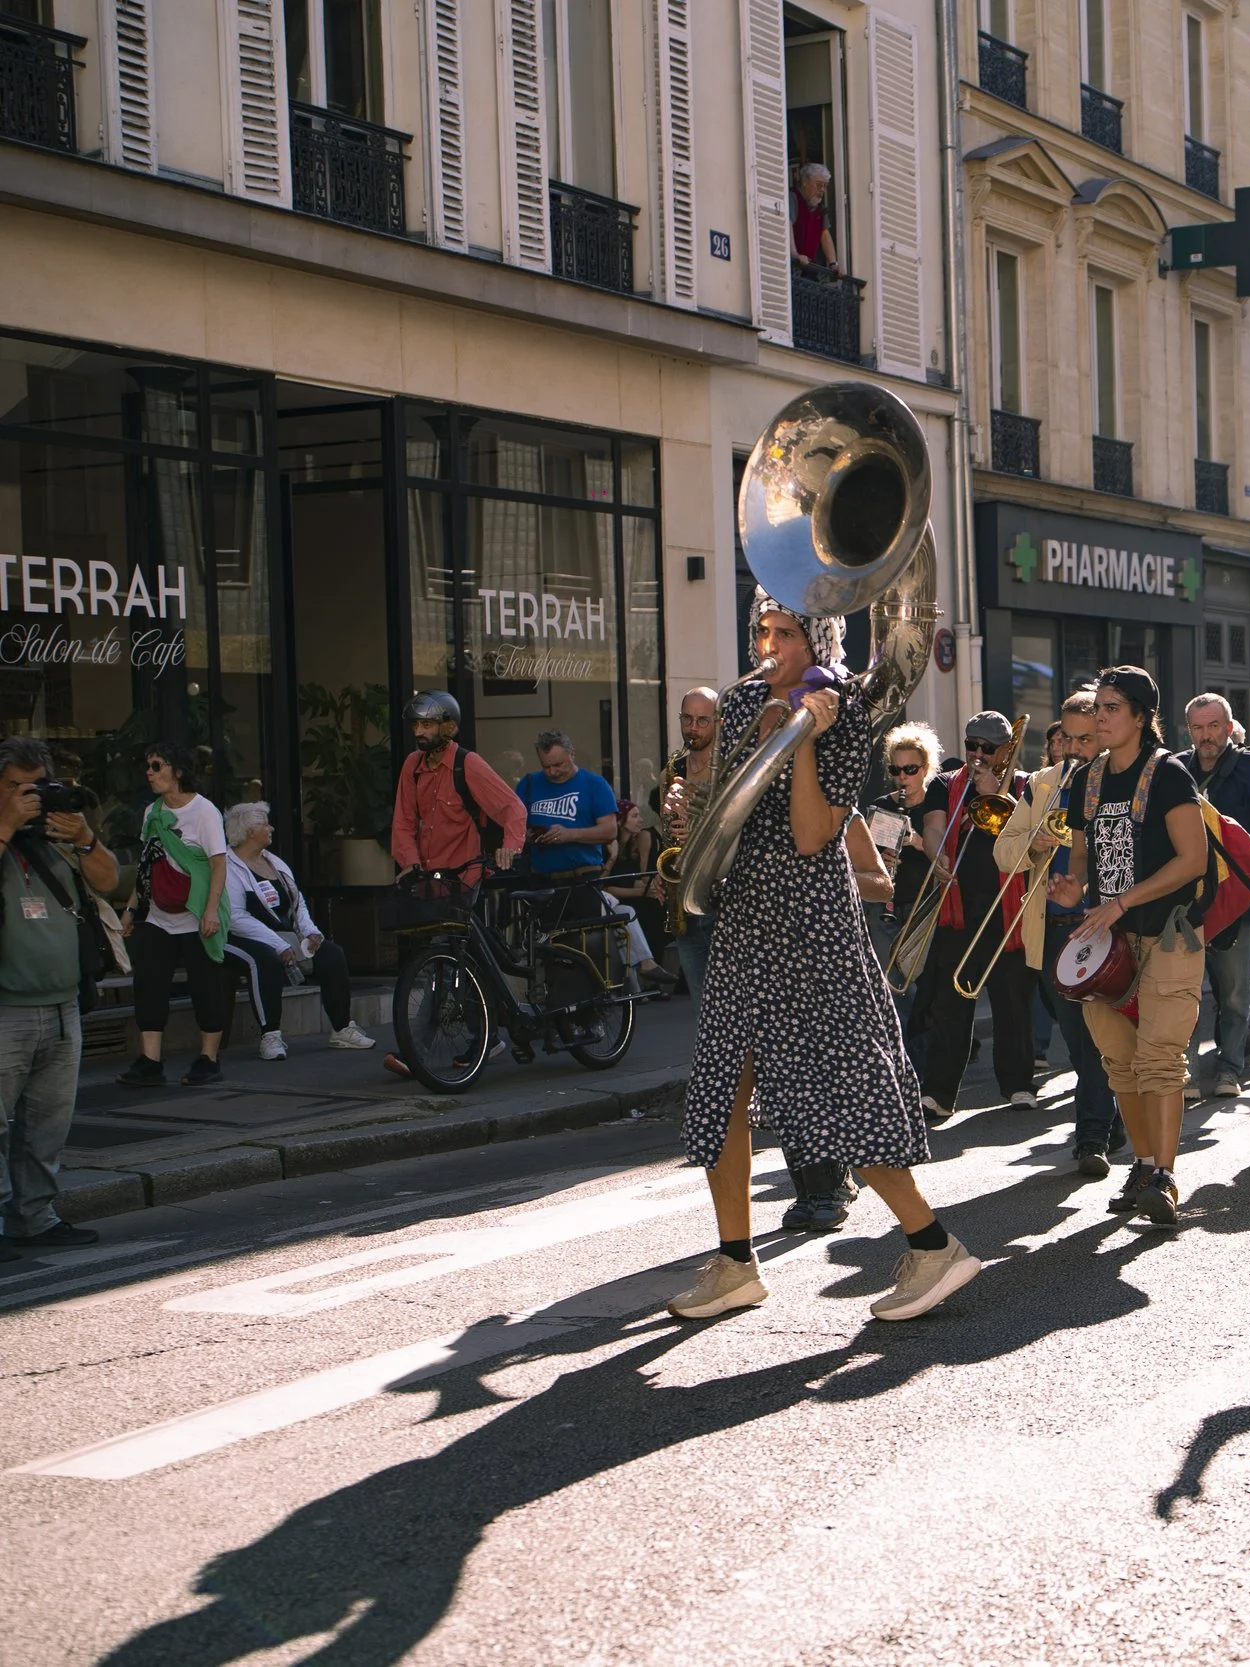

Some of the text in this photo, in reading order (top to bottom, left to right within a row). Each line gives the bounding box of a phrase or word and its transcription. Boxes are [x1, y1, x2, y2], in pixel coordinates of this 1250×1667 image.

[713, 234, 729, 258] 26
[0, 554, 187, 619] TERRAH
[1044, 538, 1175, 597] PHARMACIE
[478, 588, 605, 641] TERRAH
[0, 623, 188, 680] Salon de Café
[494, 643, 593, 689] Torréfaction
